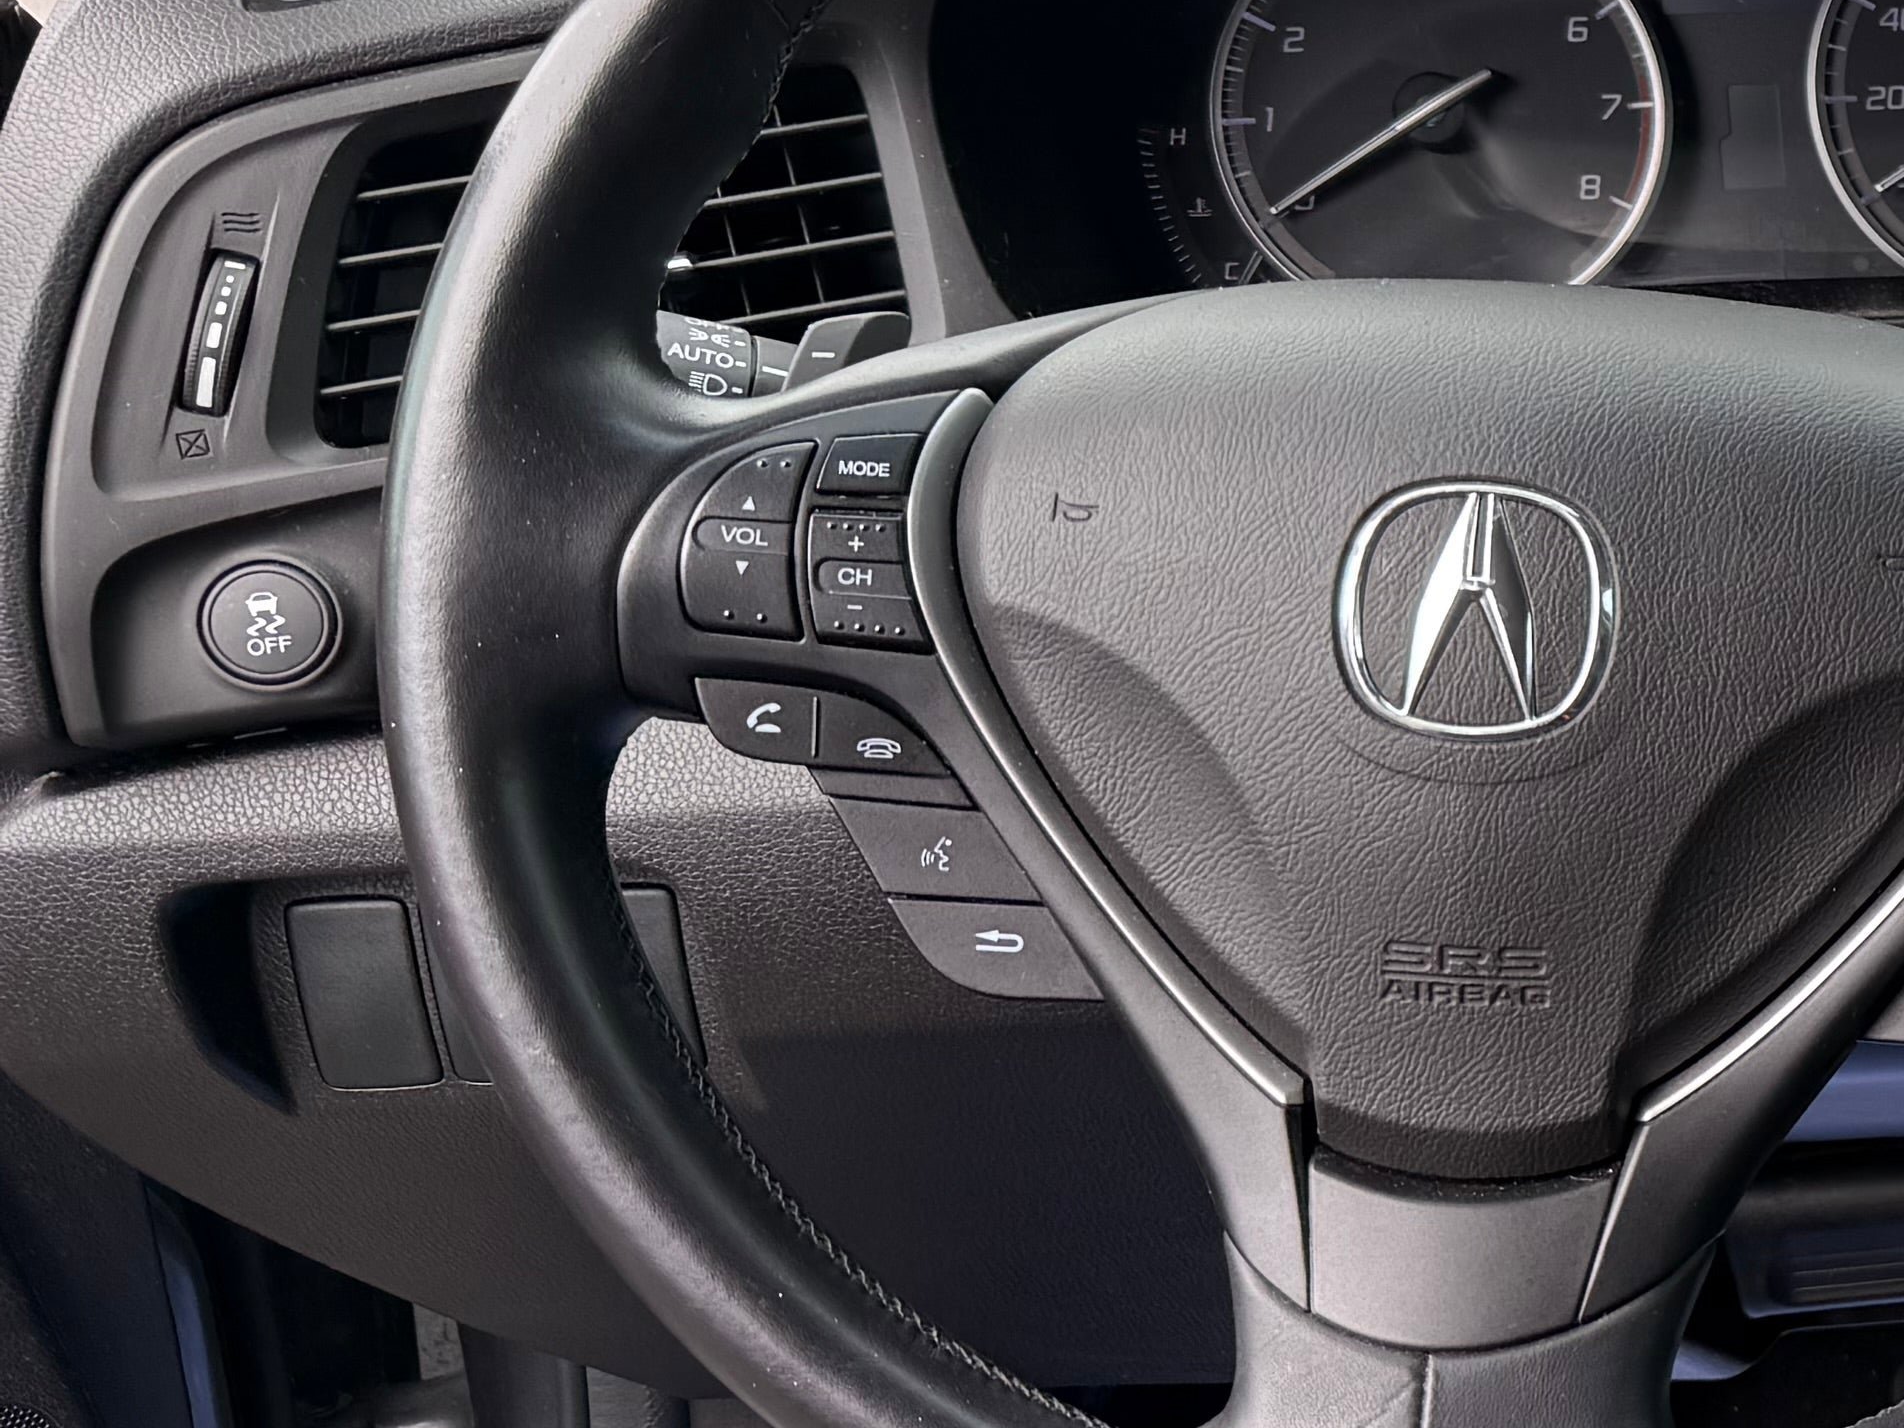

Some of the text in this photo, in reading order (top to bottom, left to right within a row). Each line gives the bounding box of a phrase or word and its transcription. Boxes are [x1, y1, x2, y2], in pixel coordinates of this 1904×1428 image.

[1282, 27, 1306, 53] 2
[1567, 16, 1589, 43] 6
[1265, 107, 1274, 132] 1
[1600, 94, 1622, 120] 7
[1169, 127, 1187, 146] H
[1579, 174, 1601, 200] 8
[1224, 262, 1240, 281] C
[667, 342, 735, 368] AUTO
[837, 460, 891, 479] MODE
[720, 525, 769, 548] VOL
[837, 567, 873, 587] CH
[246, 634, 292, 657] OFF
[1382, 940, 1548, 974] SRS
[1381, 979, 1551, 1008] AIRBAG
